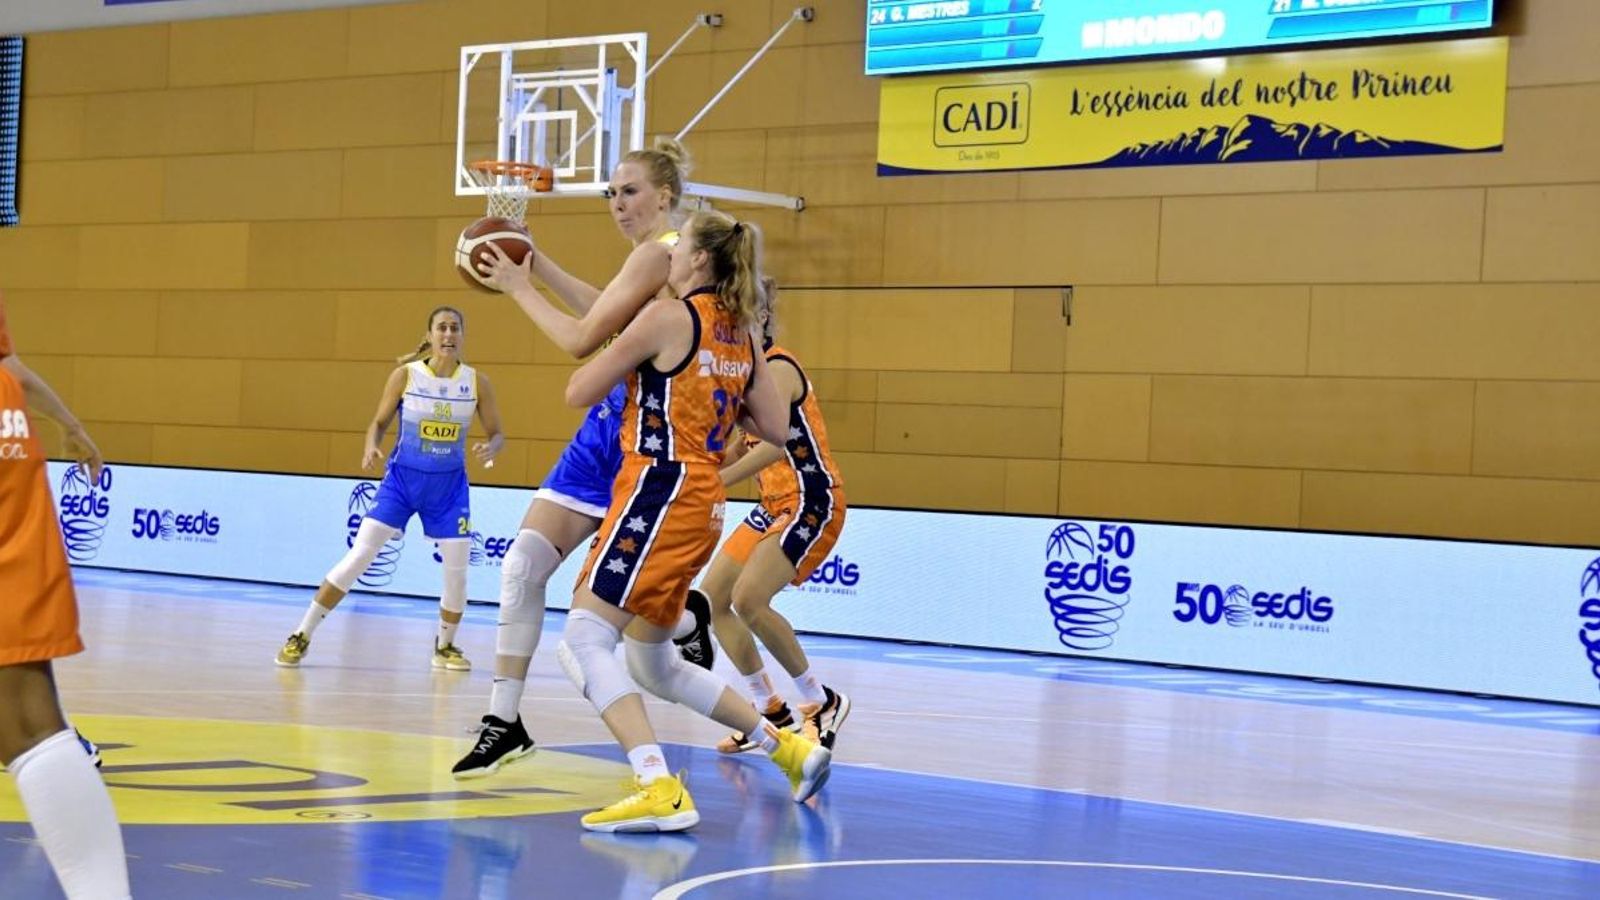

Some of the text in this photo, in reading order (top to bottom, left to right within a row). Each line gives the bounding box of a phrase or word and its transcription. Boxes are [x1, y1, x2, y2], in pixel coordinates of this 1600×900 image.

[1104, 10, 1226, 47] MONDO
[1201, 77, 1243, 108] del
[1255, 70, 1339, 107] nostre
[1352, 68, 1455, 100] Pirineu
[943, 90, 1019, 134] CADÍ
[0, 409, 29, 439] SA
[423, 425, 457, 438] CADÍ
[132, 508, 160, 539] 50
[1096, 524, 1135, 559] 50
[1172, 582, 1224, 625] 50
